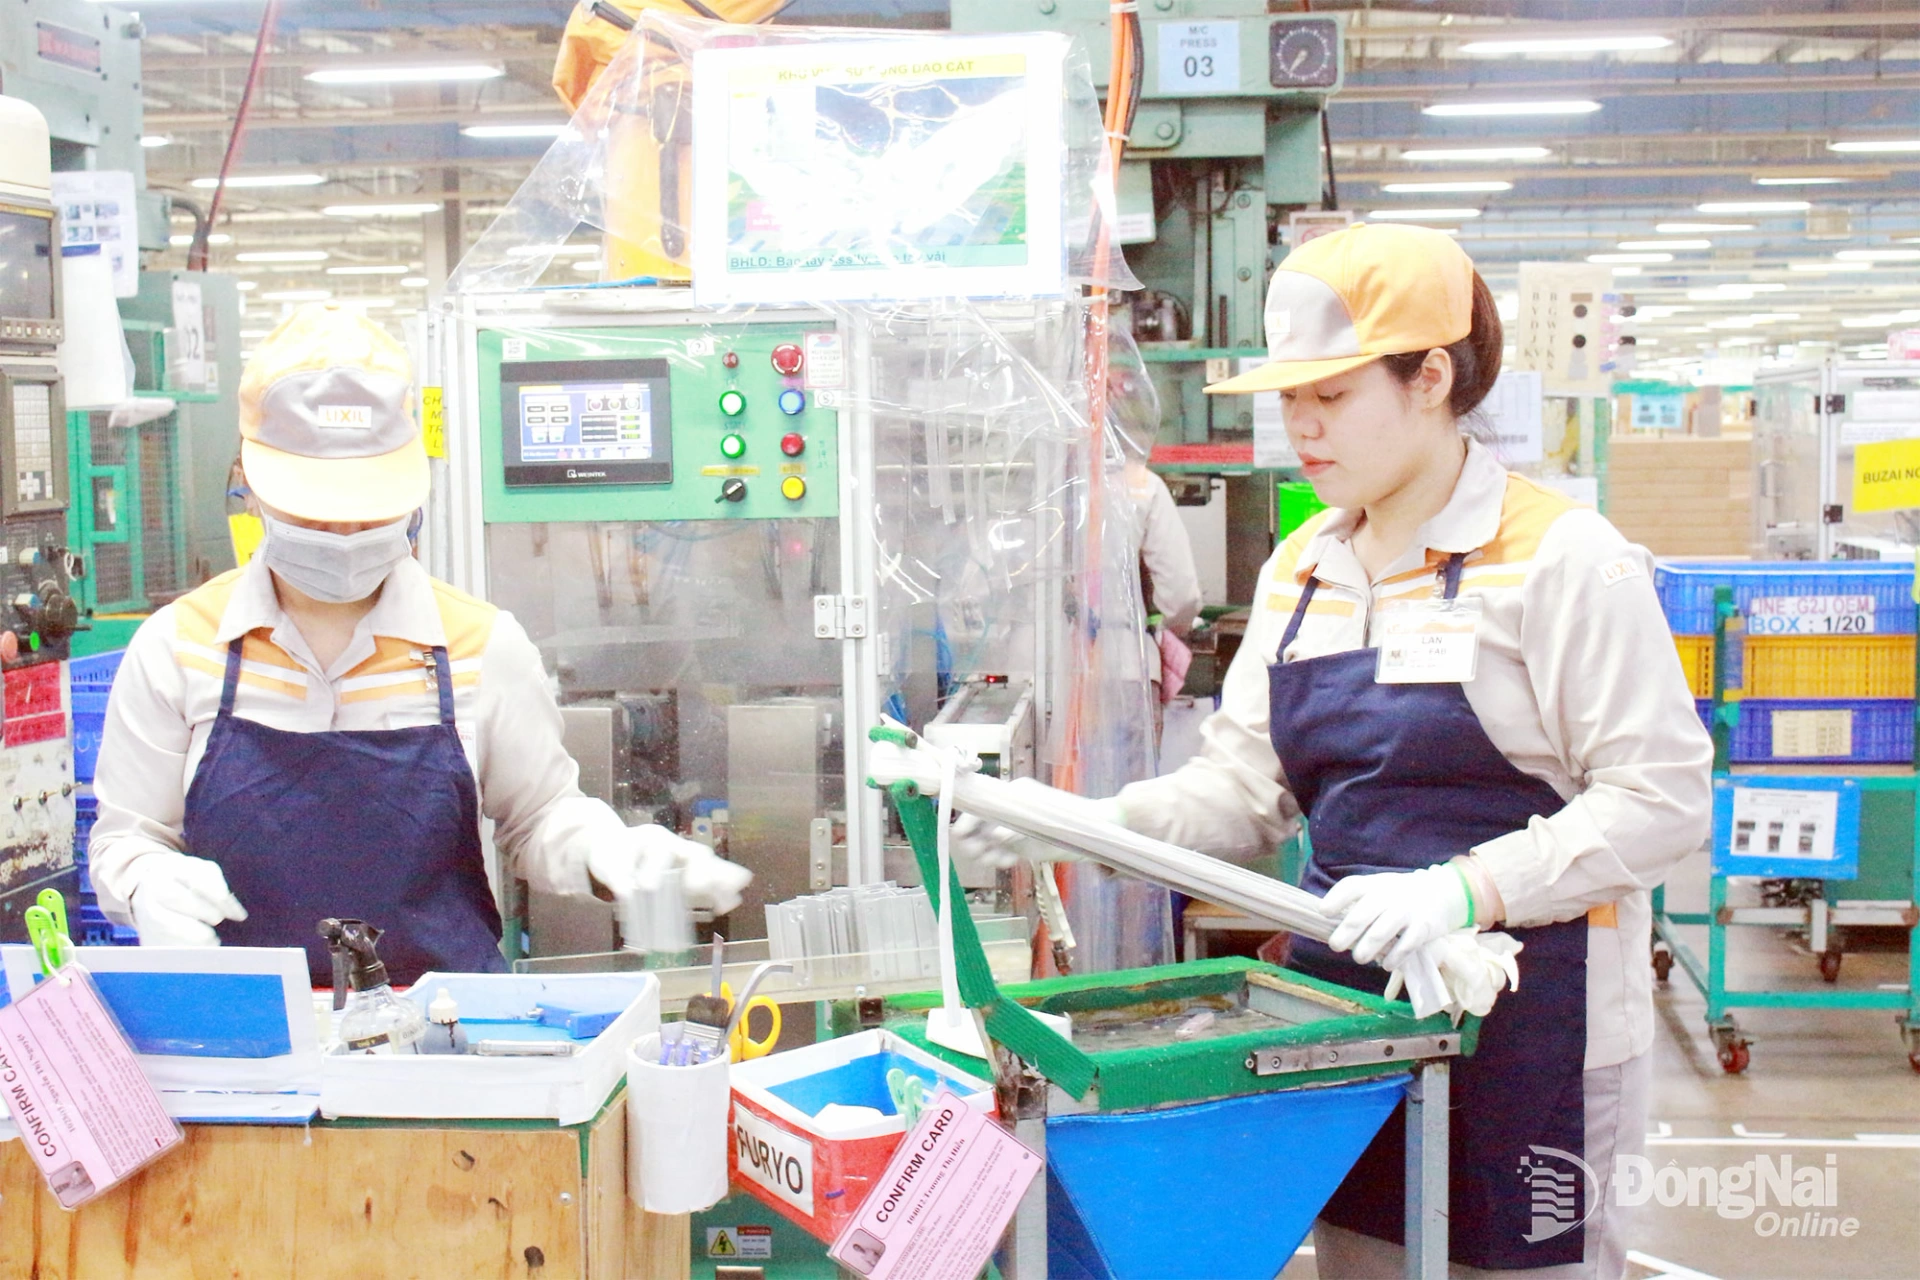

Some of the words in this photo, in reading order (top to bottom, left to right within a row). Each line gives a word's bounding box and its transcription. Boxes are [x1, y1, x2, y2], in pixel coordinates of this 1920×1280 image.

[1188, 26, 1209, 35] M/C
[1180, 37, 1217, 48] PRESS
[912, 62, 943, 74] DAO
[1184, 55, 1214, 78] 03
[325, 408, 365, 423] LIXIL
[1862, 468, 1903, 485] BUZAI
[1604, 561, 1637, 580] LIXIL
[1832, 597, 1870, 615] OEM
[1751, 615, 1801, 633] BOX
[1822, 615, 1866, 632] 1/20
[1421, 636, 1443, 645] LAN
[9, 1083, 58, 1158] CONFIRM
[736, 1123, 804, 1195] FURYO
[874, 1151, 925, 1224] CONFIRM
[919, 1106, 955, 1153] CARD
